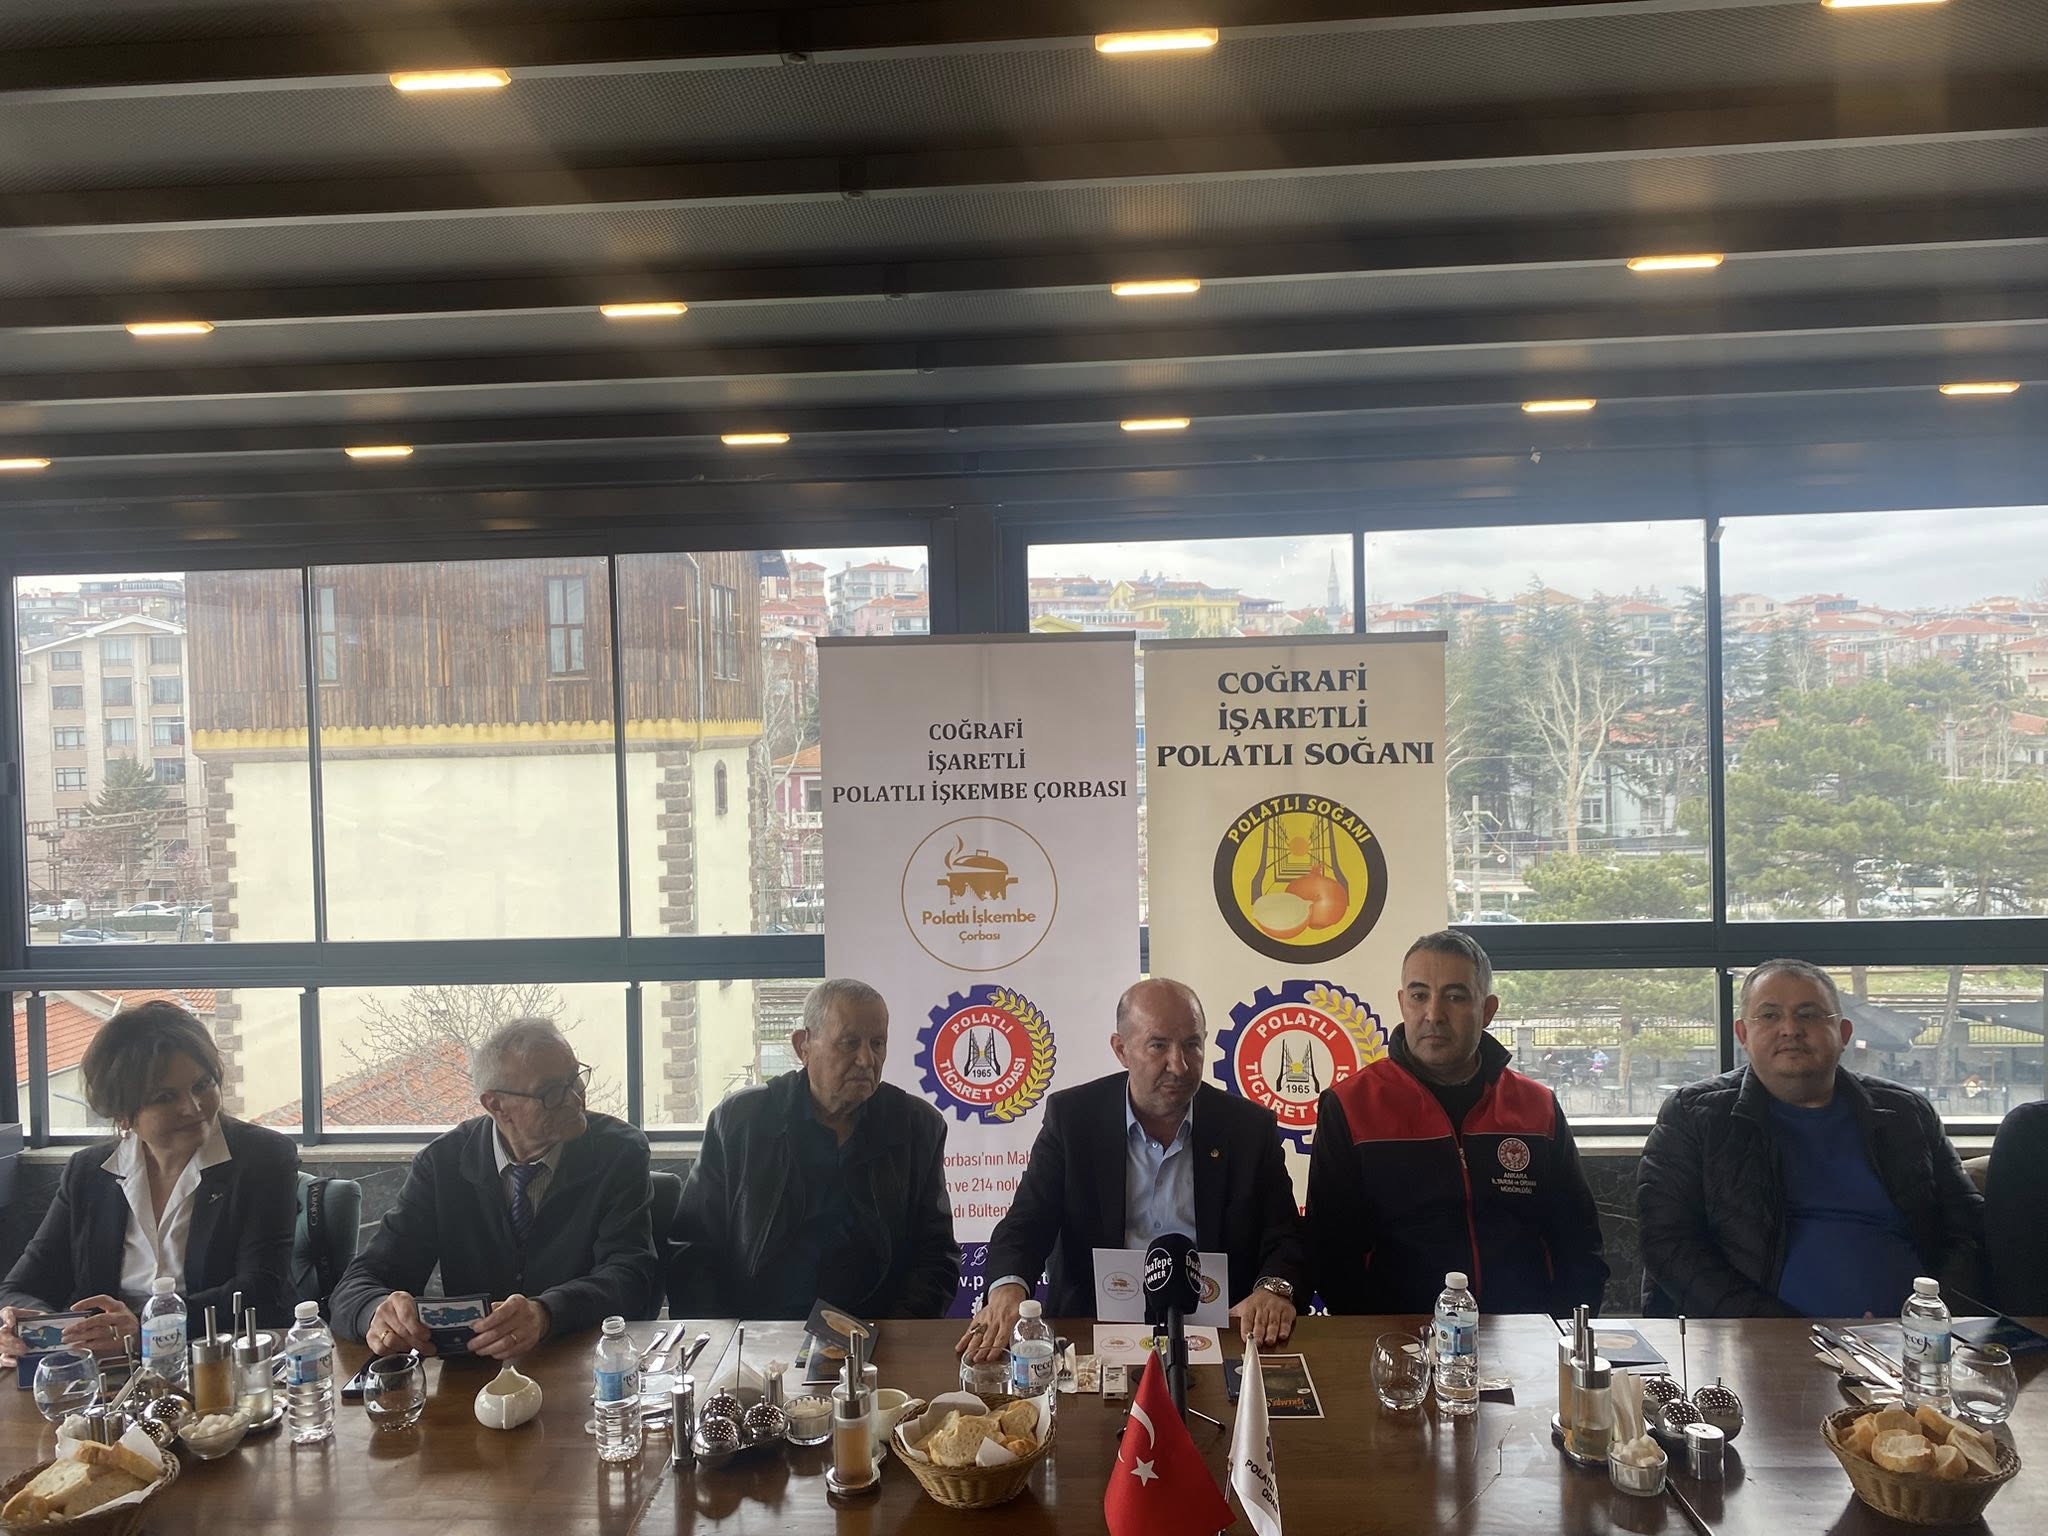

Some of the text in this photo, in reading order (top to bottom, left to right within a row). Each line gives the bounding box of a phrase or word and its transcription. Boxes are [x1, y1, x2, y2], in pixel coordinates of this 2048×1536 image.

[1217, 663, 1369, 695] COĞRAFİ
[928, 718, 1024, 741] COĞRAFİ
[1218, 706, 1369, 738] İŞARETLİ
[928, 750, 1026, 774] İŞARETLİ
[1156, 736, 1435, 768] POLATLI SOĞANI
[832, 779, 1127, 806] POLATLI İŞKEMBE ÇORBASI
[1228, 796, 1372, 844] POLATLI SOĞANI
[922, 906, 1036, 927] Polatlı İşkembe
[959, 930, 1000, 943] Çorbası
[950, 1012, 1015, 1034] POLATLI
[1256, 1012, 1338, 1041] POLATLI
[939, 1057, 1026, 1100] TİCARET ODASI
[972, 1069, 992, 1078] 1965
[1286, 1084, 1310, 1094] 1965
[944, 1151, 1003, 1167] orbası'nın
[955, 1181, 968, 1192] ve
[972, 1178, 993, 1192] 214
[968, 1202, 1011, 1218] Bülten
